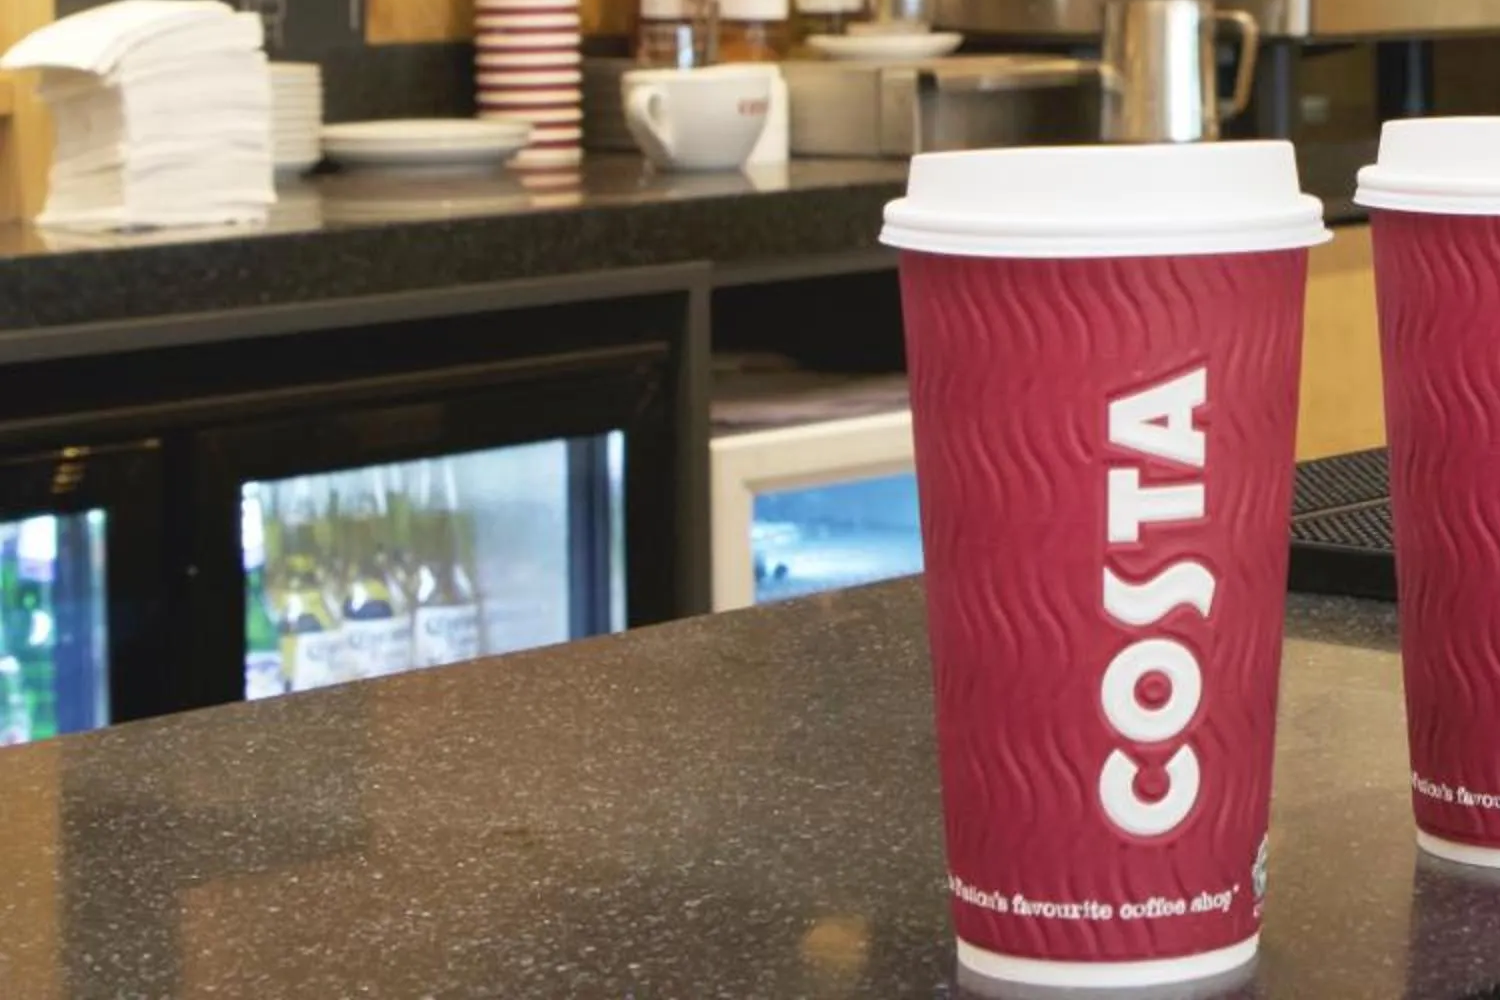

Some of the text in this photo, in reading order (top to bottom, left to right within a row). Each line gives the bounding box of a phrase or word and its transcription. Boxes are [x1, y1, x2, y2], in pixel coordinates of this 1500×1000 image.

[1099, 366, 1217, 837] COSTA
[1012, 892, 1113, 920] favourite
[1119, 896, 1187, 920] coffee
